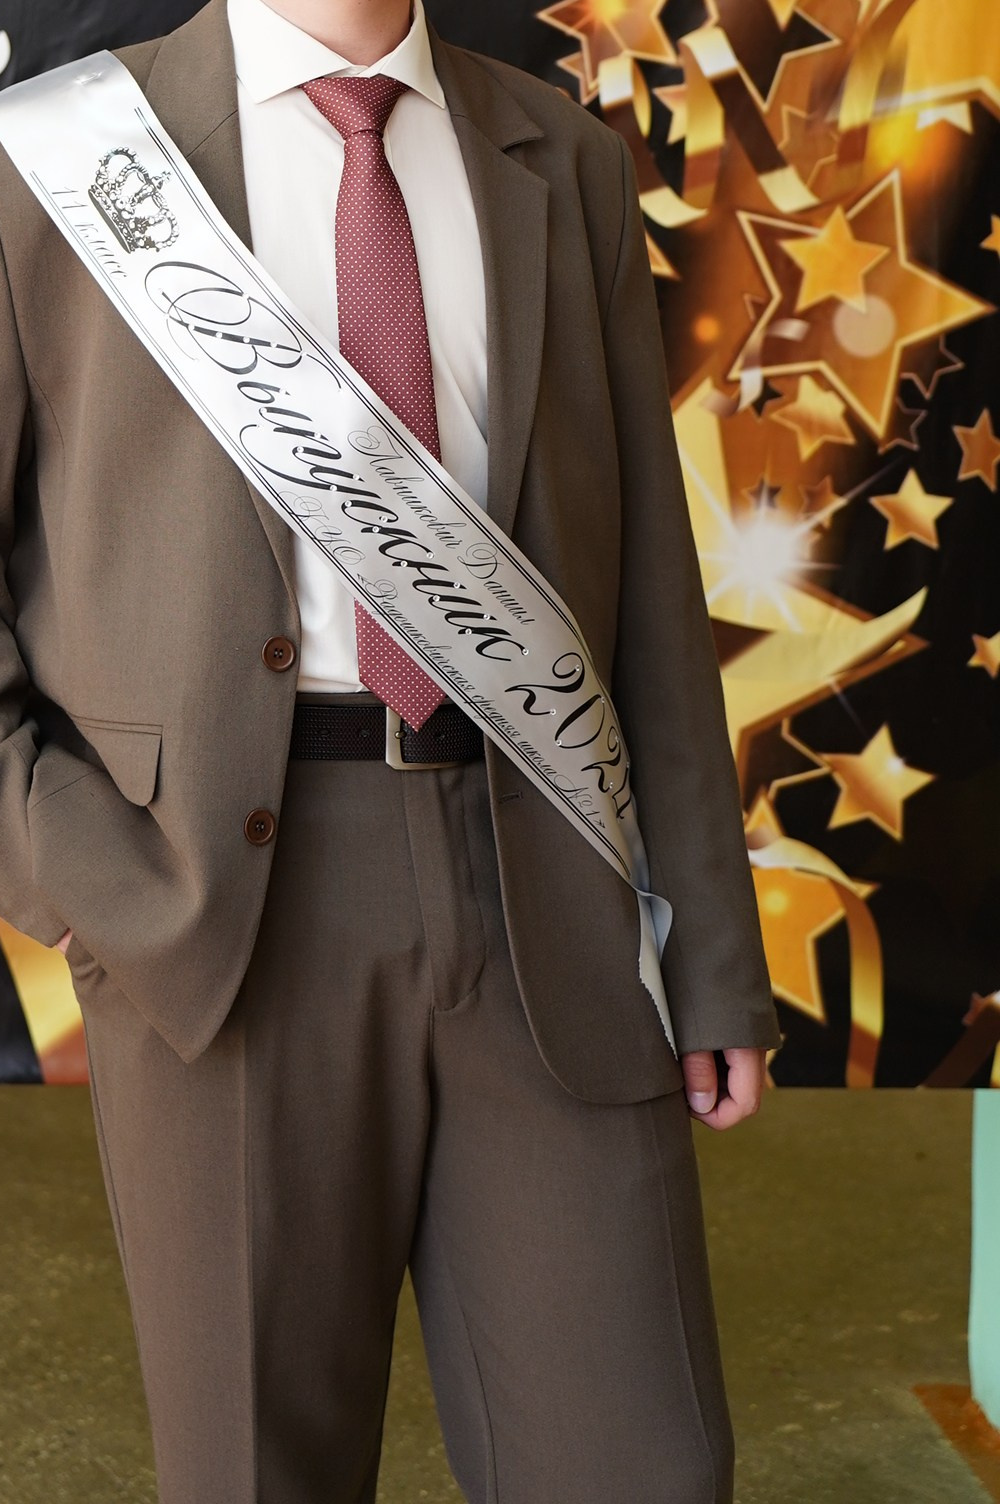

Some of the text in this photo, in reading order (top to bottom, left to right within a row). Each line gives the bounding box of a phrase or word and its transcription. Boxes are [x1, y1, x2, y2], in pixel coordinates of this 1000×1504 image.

[51, 187, 126, 277] 11 класс
[144, 261, 529, 661] Выпускник
[456, 542, 535, 624] Даниил
[464, 692, 520, 739] средняя
[518, 739, 559, 776] школа
